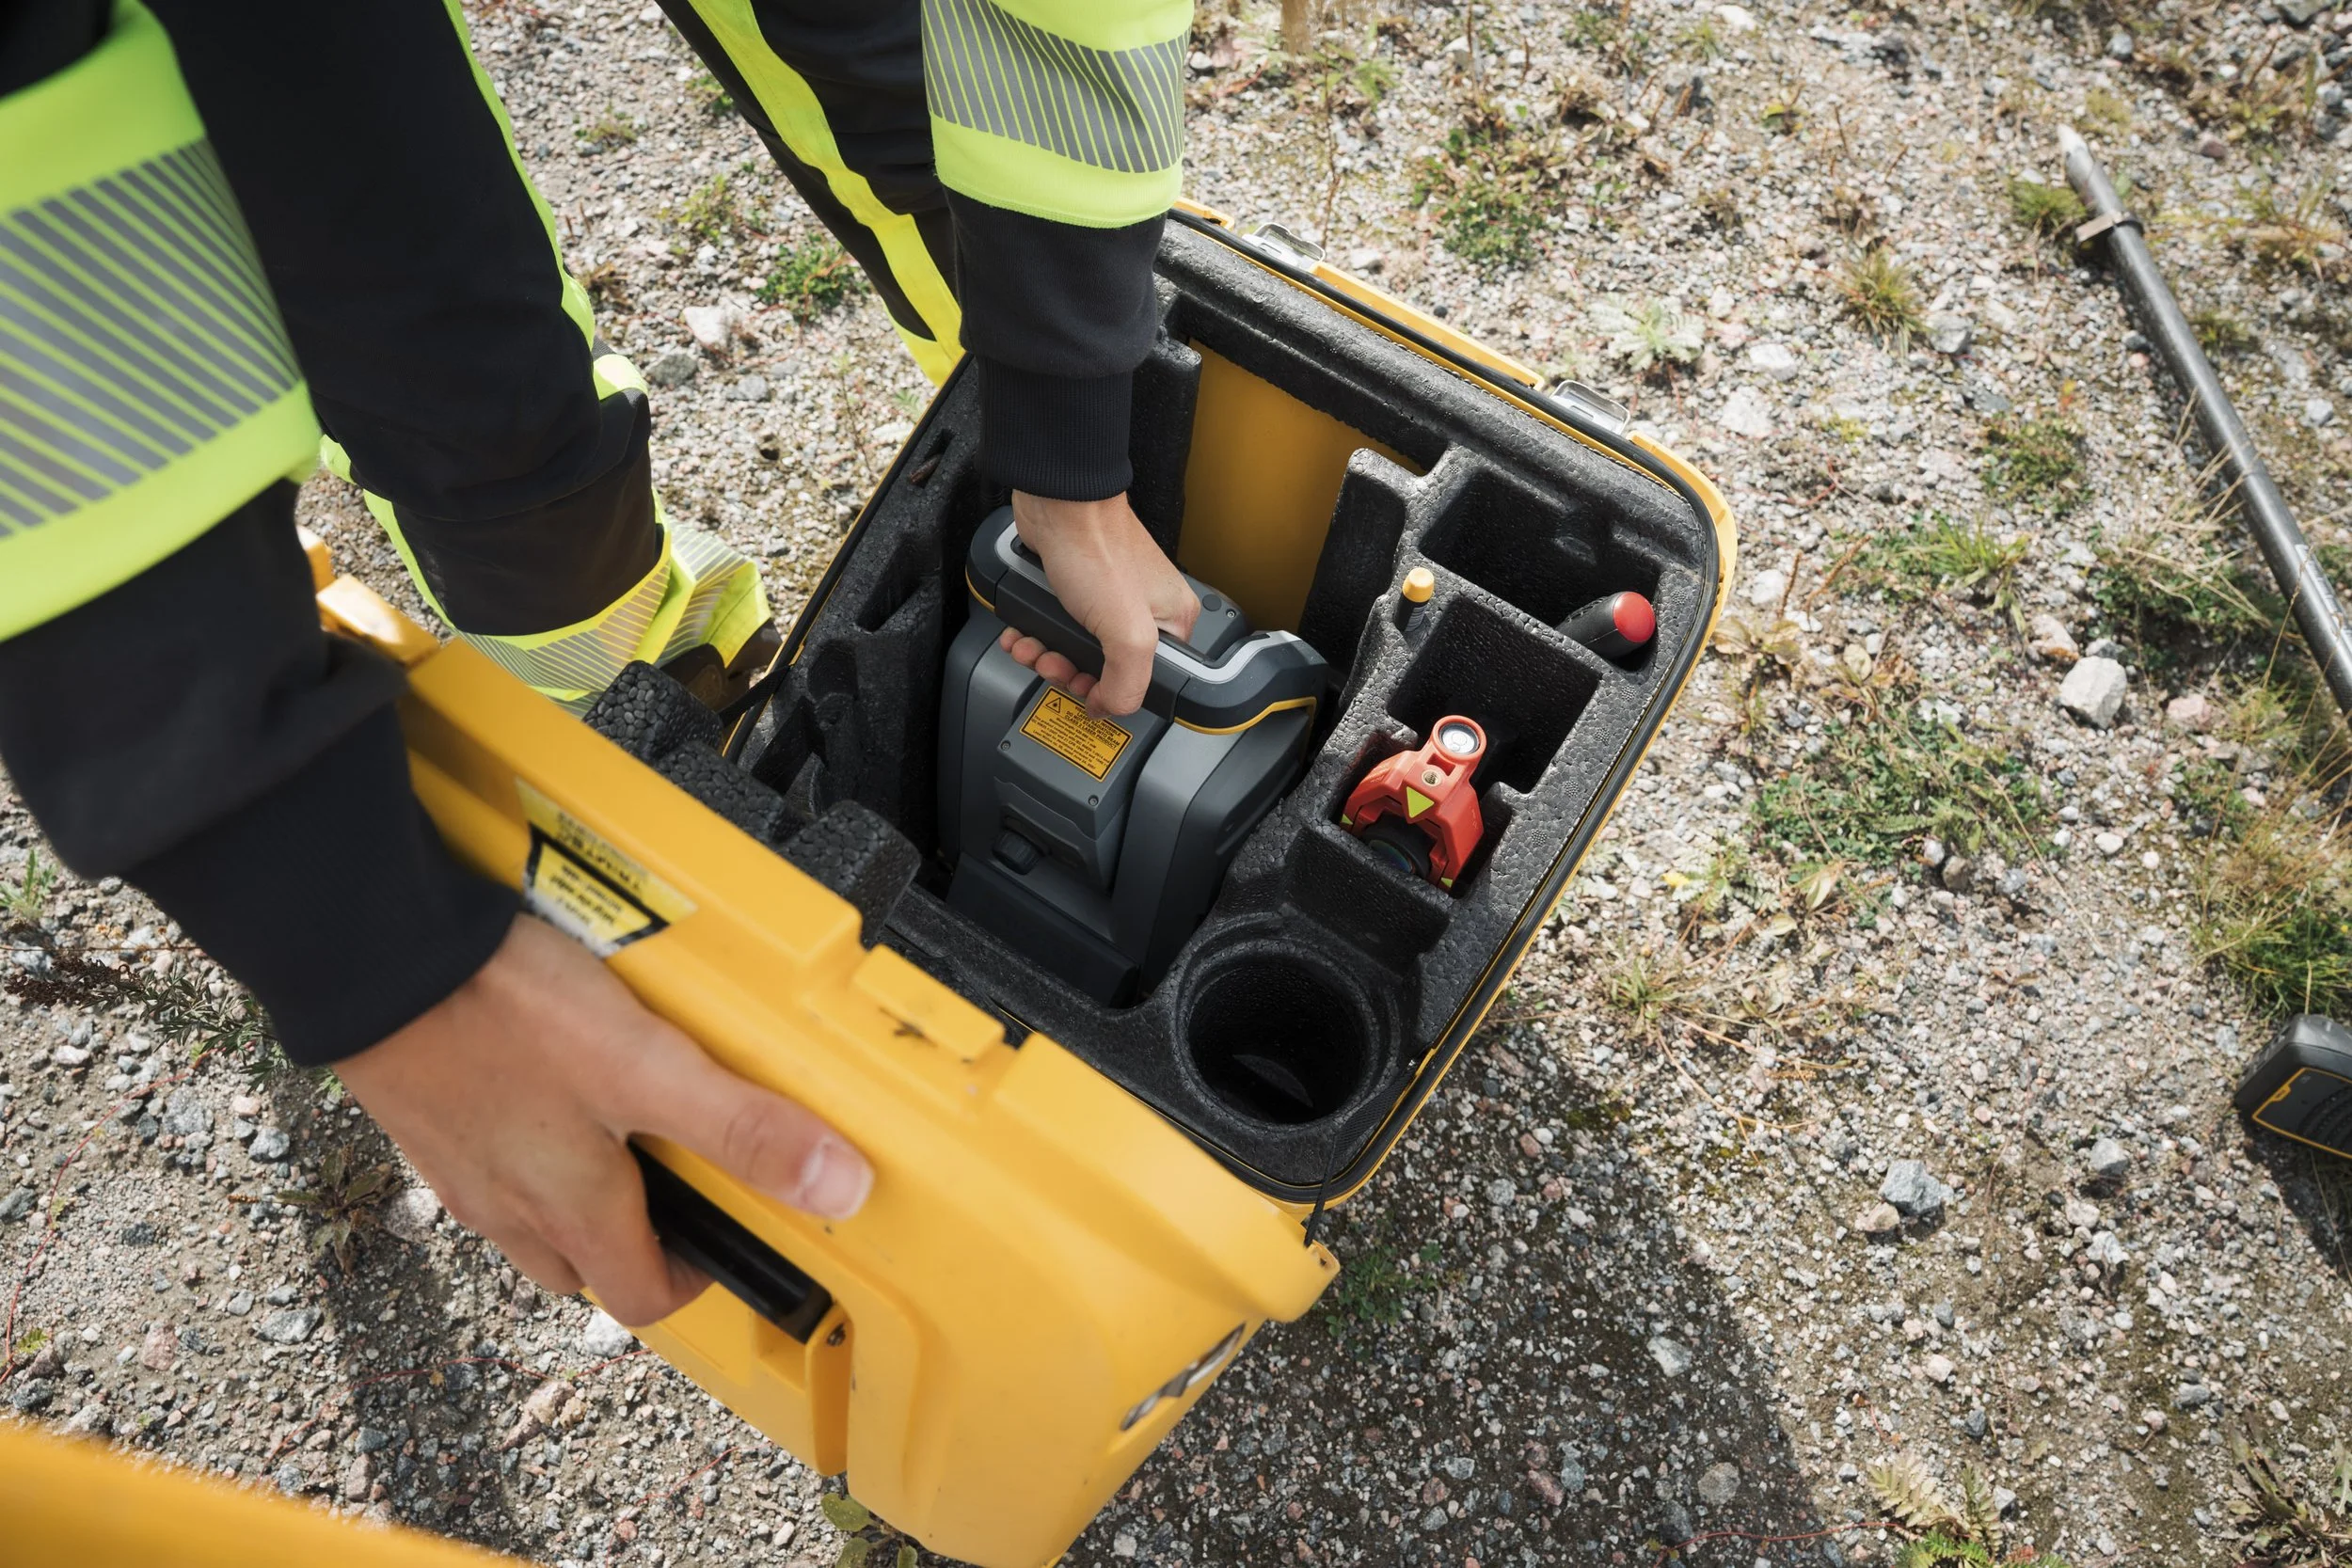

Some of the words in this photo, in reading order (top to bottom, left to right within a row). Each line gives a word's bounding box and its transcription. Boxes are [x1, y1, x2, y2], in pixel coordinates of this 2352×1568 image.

[1063, 714, 1079, 725] CLASS
[1081, 725, 1096, 736] LASER
[1095, 734, 1117, 749] PRODUCT
[1074, 705, 1089, 717] VISIB
[1099, 721, 1121, 736] INVISIBLE
[1076, 711, 1091, 722] LASER
[1089, 721, 1114, 736] RADIATION
[1081, 720, 1096, 731] STARE
[1095, 729, 1107, 737] INTO
[1106, 736, 1120, 746] BEAM
